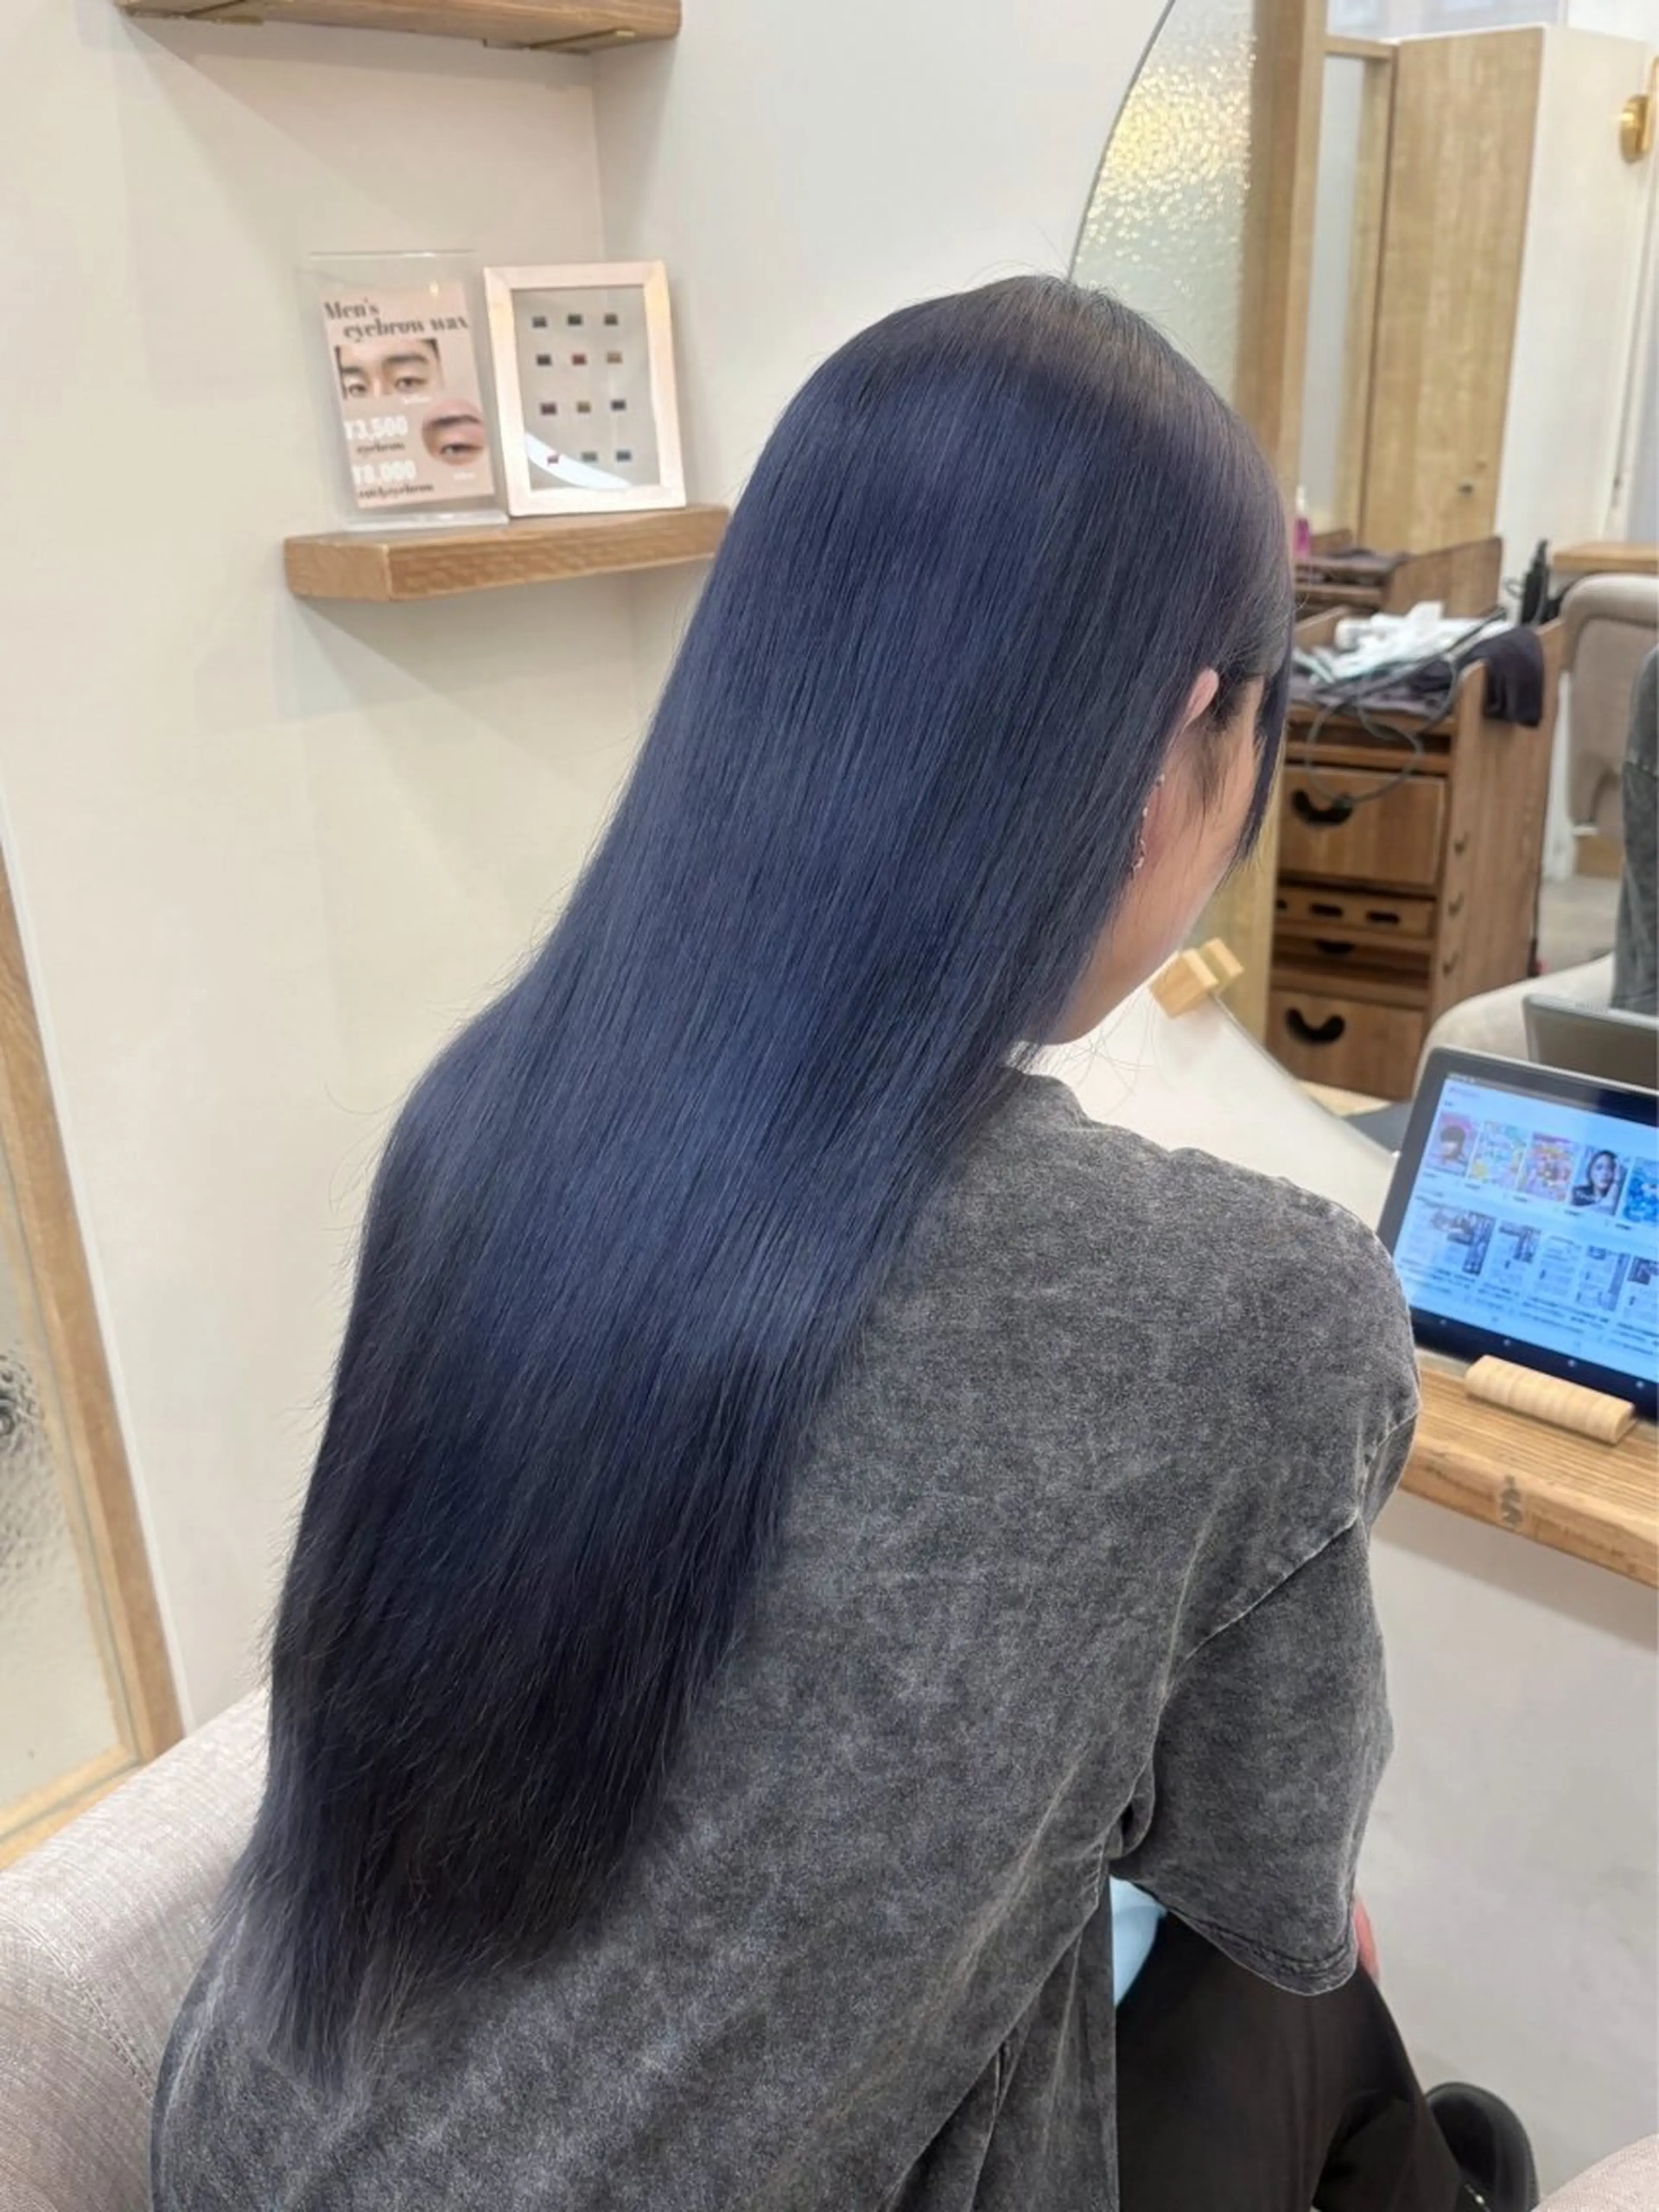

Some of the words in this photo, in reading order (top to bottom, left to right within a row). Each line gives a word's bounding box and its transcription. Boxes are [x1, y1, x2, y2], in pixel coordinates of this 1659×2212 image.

[324, 297, 380, 320] Men's
[343, 317, 425, 343] eyebrow
[429, 316, 468, 331] wax
